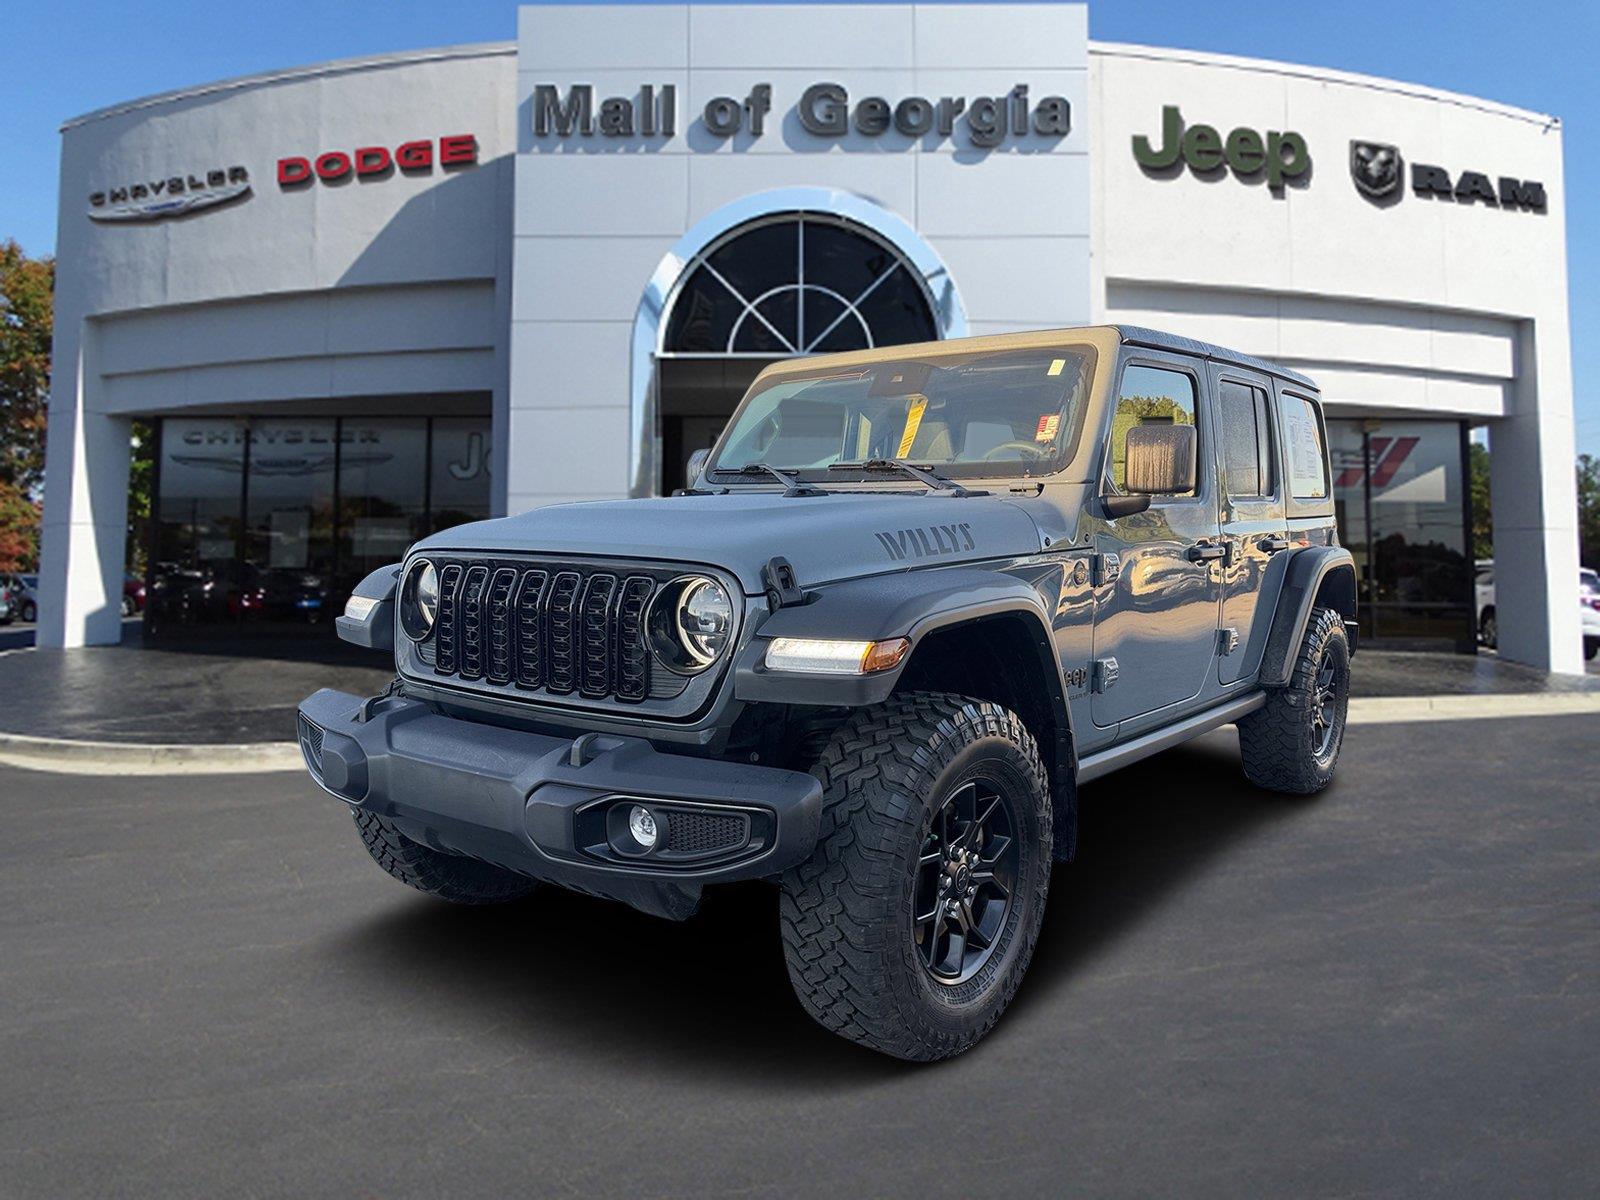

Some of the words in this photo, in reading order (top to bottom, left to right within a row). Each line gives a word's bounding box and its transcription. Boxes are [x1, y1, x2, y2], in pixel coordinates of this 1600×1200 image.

[532, 84, 676, 137] Mall
[703, 83, 771, 136] of
[798, 82, 1072, 148] Georgia
[277, 134, 479, 185] DODGE
[1131, 105, 1309, 198] Jeep
[89, 166, 249, 207] CHRYSLER
[1411, 162, 1548, 213] RAM
[874, 523, 975, 561] WILLYS
